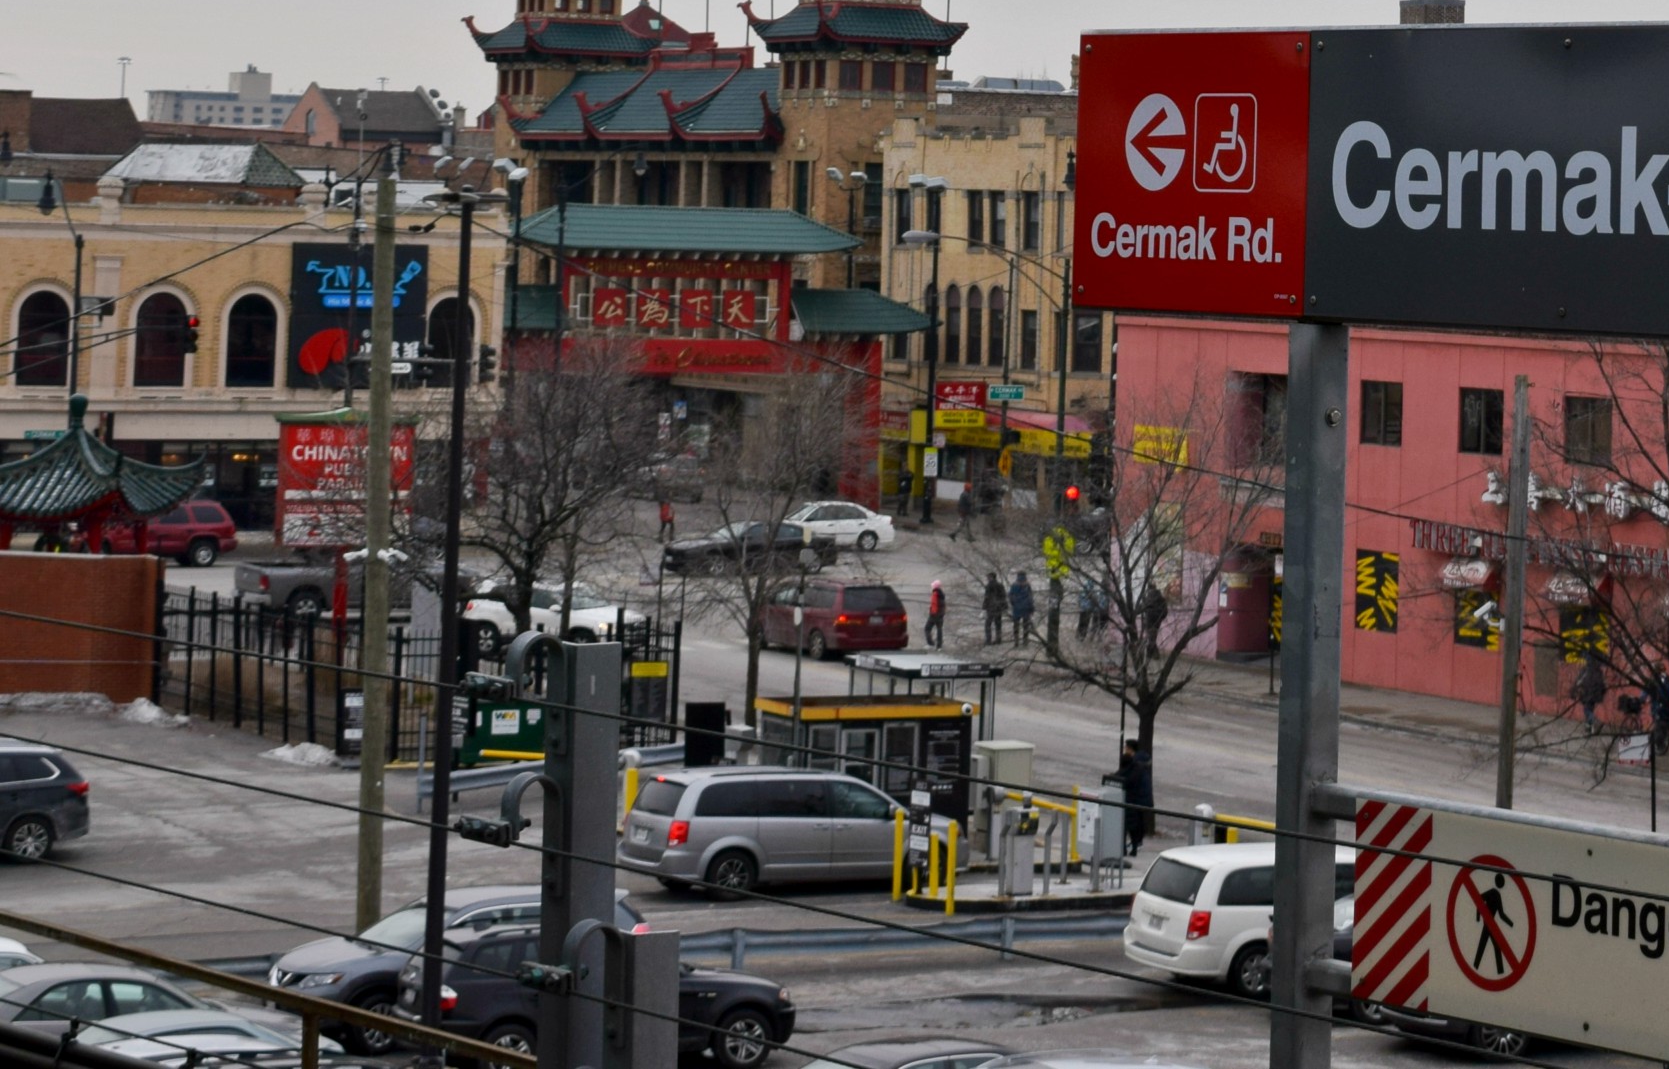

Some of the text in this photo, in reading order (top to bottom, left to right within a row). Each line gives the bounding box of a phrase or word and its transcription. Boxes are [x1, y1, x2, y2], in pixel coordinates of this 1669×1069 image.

[1091, 212, 1282, 263] Cermak Rd.
[1409, 518, 1476, 555] THREE
[912, 824, 928, 835] EXIT
